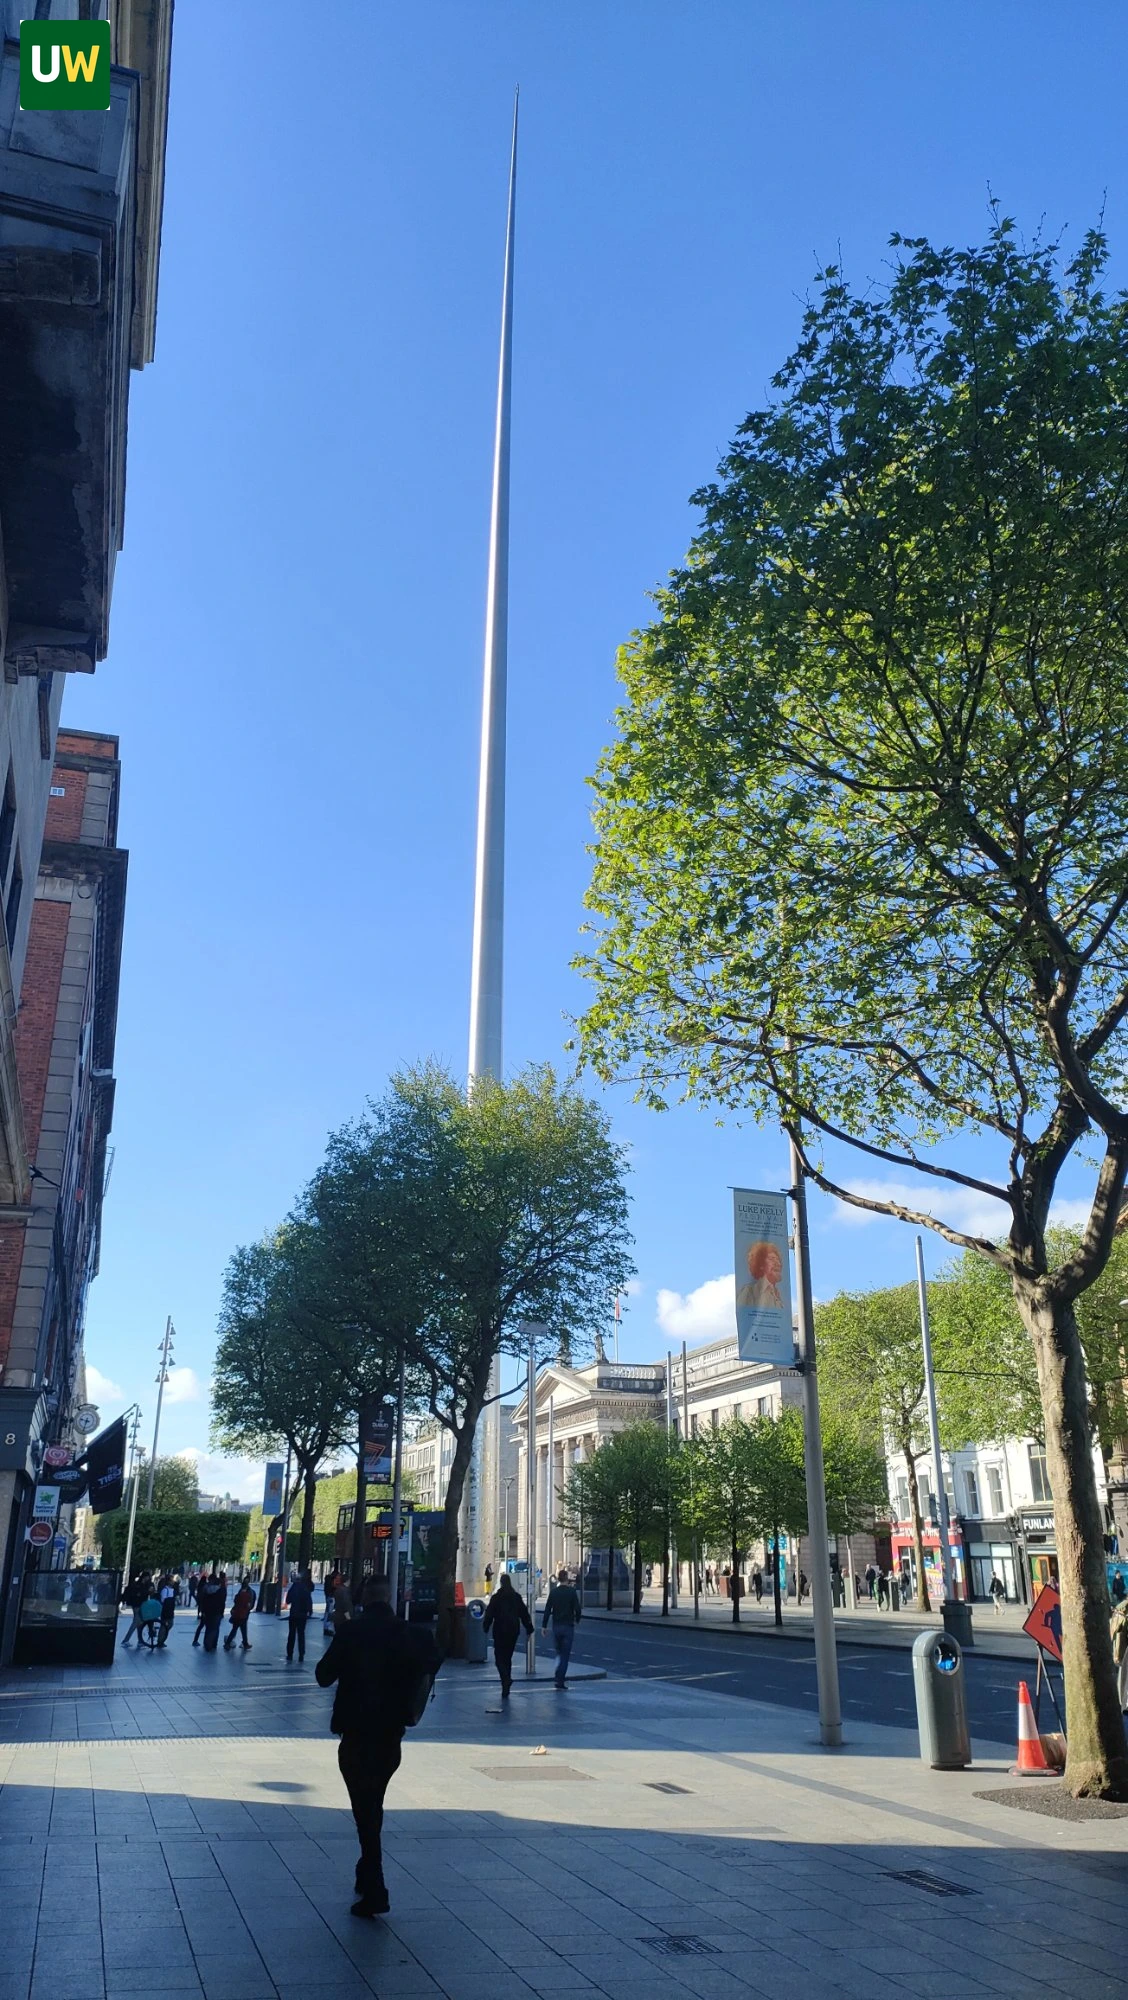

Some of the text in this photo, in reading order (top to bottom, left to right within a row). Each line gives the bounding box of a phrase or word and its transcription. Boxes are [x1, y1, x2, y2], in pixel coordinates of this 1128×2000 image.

[738, 1204, 759, 1214] LUKE
[760, 1207, 784, 1216] KELLY
[5, 1433, 15, 1445] 8
[1023, 1518, 1055, 1530] FUNLAN
